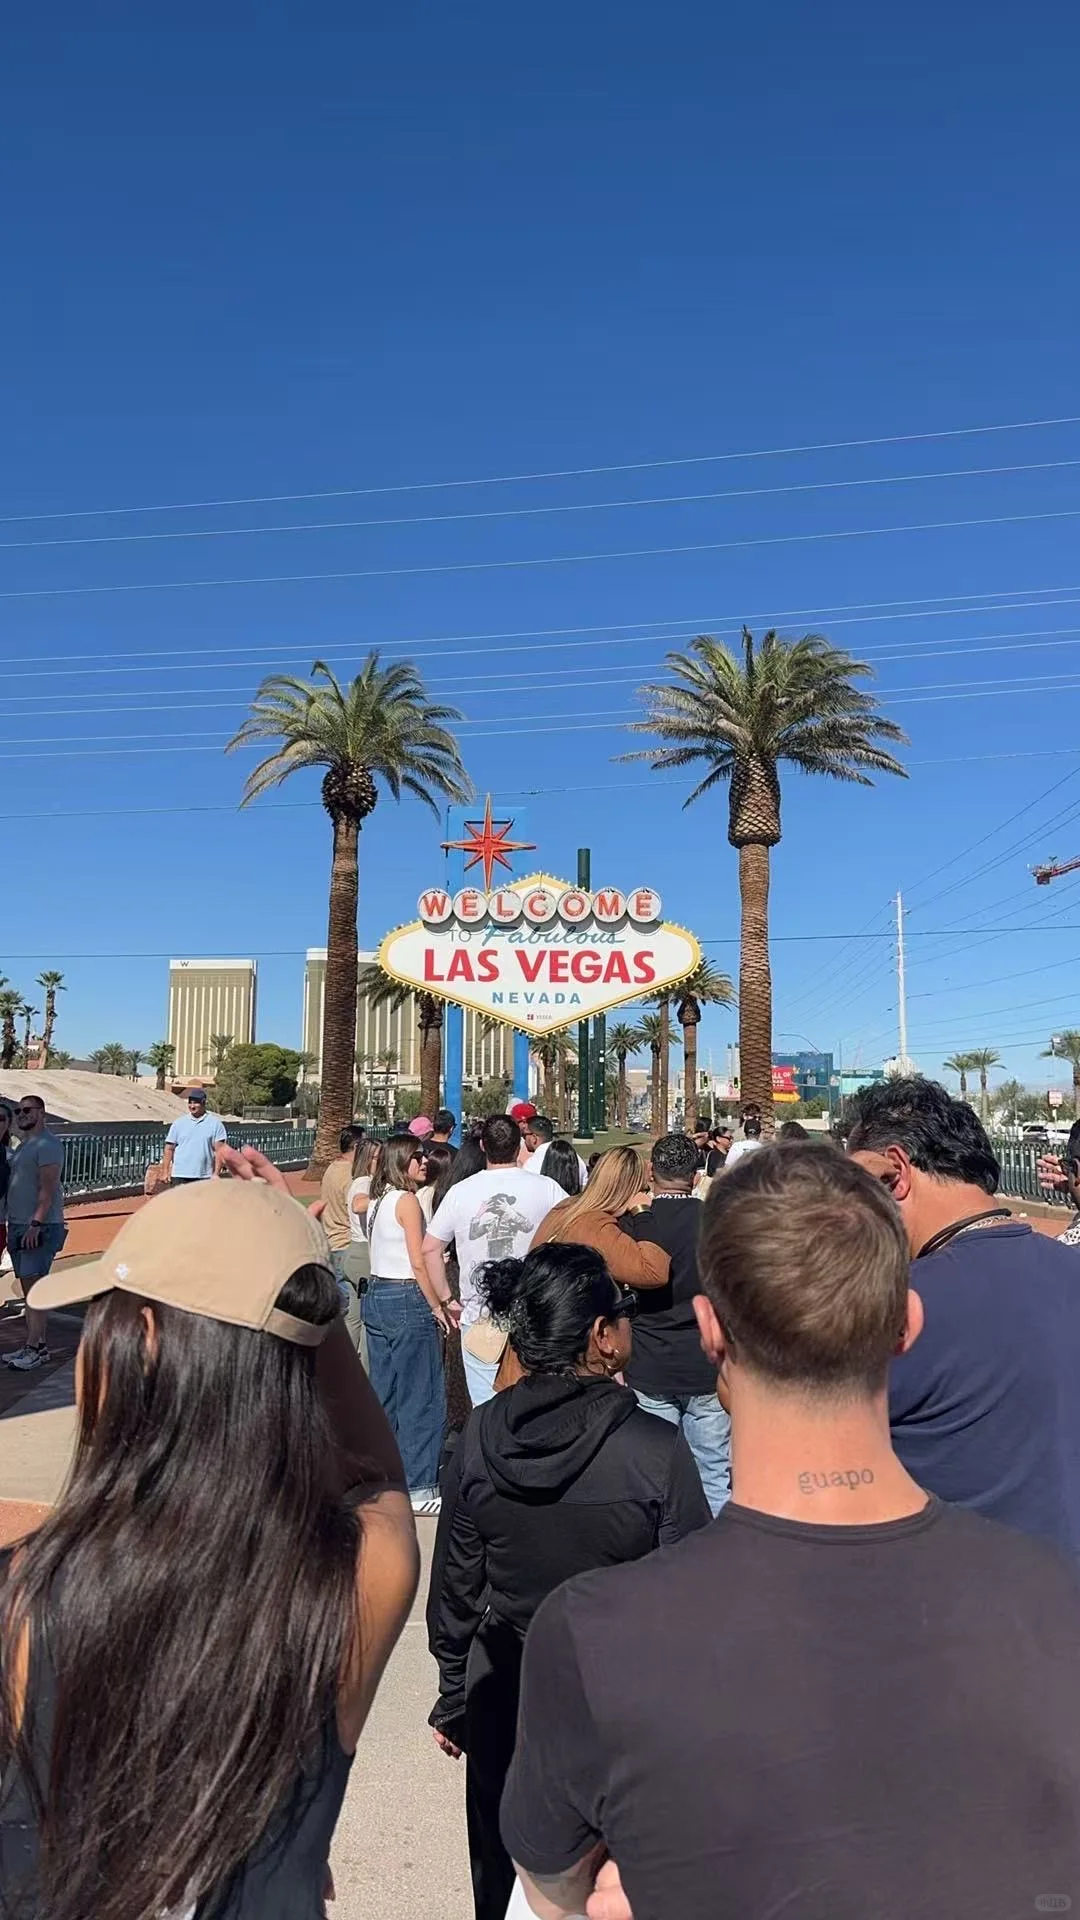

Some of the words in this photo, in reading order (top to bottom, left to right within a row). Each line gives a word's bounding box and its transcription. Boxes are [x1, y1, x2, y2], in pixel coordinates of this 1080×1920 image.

[421, 895, 653, 917] WELCOME
[449, 929, 472, 943] TO
[481, 925, 625, 947] Fabulous
[424, 949, 500, 982] LAS
[515, 950, 656, 984] VEGAS
[492, 992, 581, 1004] NEVADA
[799, 1468, 875, 1495] guapo
